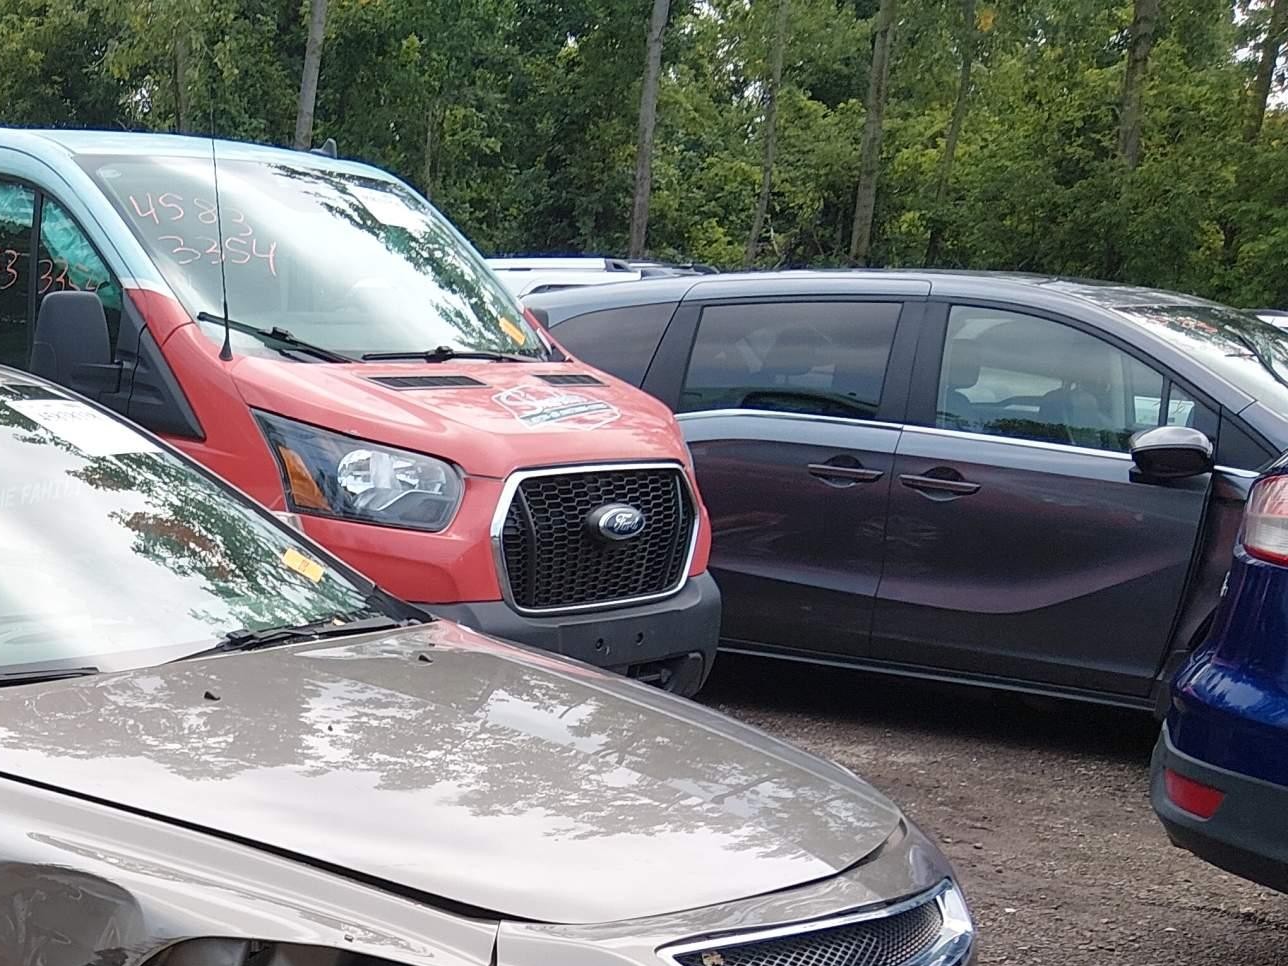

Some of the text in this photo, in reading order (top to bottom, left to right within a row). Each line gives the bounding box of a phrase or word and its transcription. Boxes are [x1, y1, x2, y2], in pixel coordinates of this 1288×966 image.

[129, 193, 253, 237] 4583
[156, 235, 277, 277] 3354
[613, 512, 640, 532] Ford
